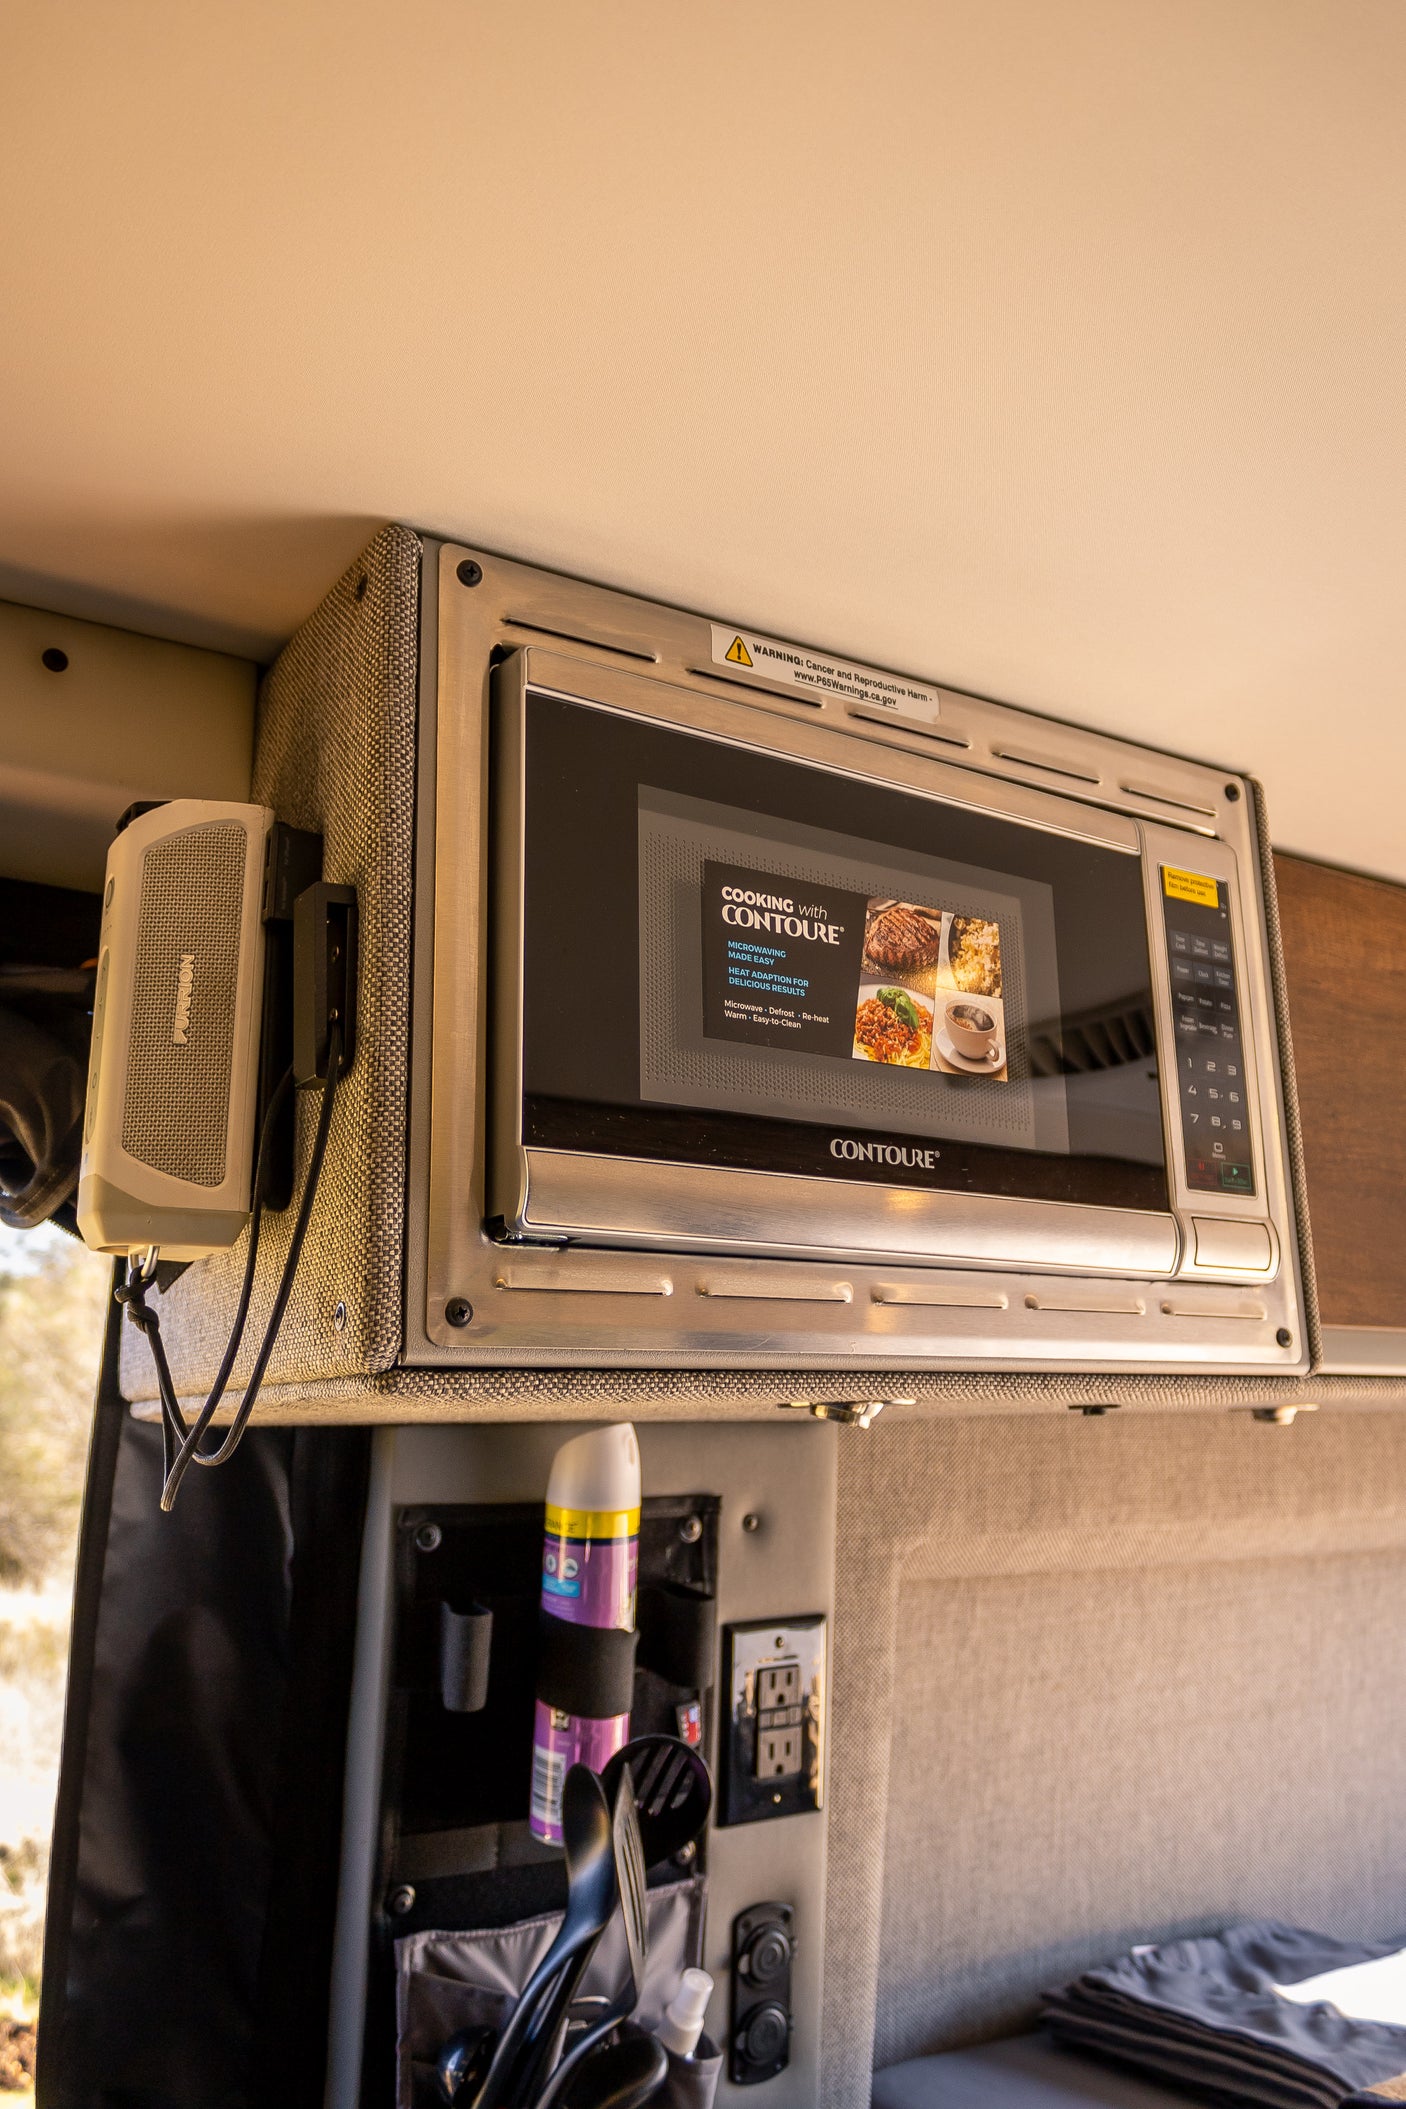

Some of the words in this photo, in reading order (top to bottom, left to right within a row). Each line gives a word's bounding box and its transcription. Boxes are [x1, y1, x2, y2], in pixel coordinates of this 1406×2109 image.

[752, 643, 804, 666] WARNING:
[805, 659, 835, 675] Cancer
[837, 670, 852, 681] and
[854, 673, 906, 696] Reproductive
[907, 688, 928, 702] Harm
[793, 670, 897, 706] www.P65Warnings.ca.gov
[721, 886, 794, 913] COOKING
[798, 904, 828, 920] with
[728, 940, 787, 959] MICROWAVING
[728, 950, 753, 962] MADE
[753, 955, 775, 966] EASY
[728, 966, 750, 977] HEAT
[751, 970, 792, 985] ADAPTION
[793, 977, 809, 988] FOR
[728, 976, 771, 991] DELICIOUS
[771, 984, 806, 997] RESULTS
[172, 954, 195, 1045] FURRION
[724, 1000, 763, 1013] Microwave
[769, 1006, 795, 1018] Defrost
[802, 1012, 830, 1024] Re-heat
[724, 1009, 747, 1020] Warm
[752, 1014, 802, 1029] Easy-to-Clean
[1188, 1057, 1193, 1069] 1
[1207, 1061, 1216, 1073] 2
[1227, 1064, 1236, 1076] 3
[1188, 1084, 1197, 1096] 4
[1209, 1088, 1218, 1099] 5
[1230, 1092, 1239, 1103] 6
[1190, 1113, 1200, 1125] 7
[1211, 1116, 1221, 1127] 8
[1232, 1119, 1242, 1130] 9
